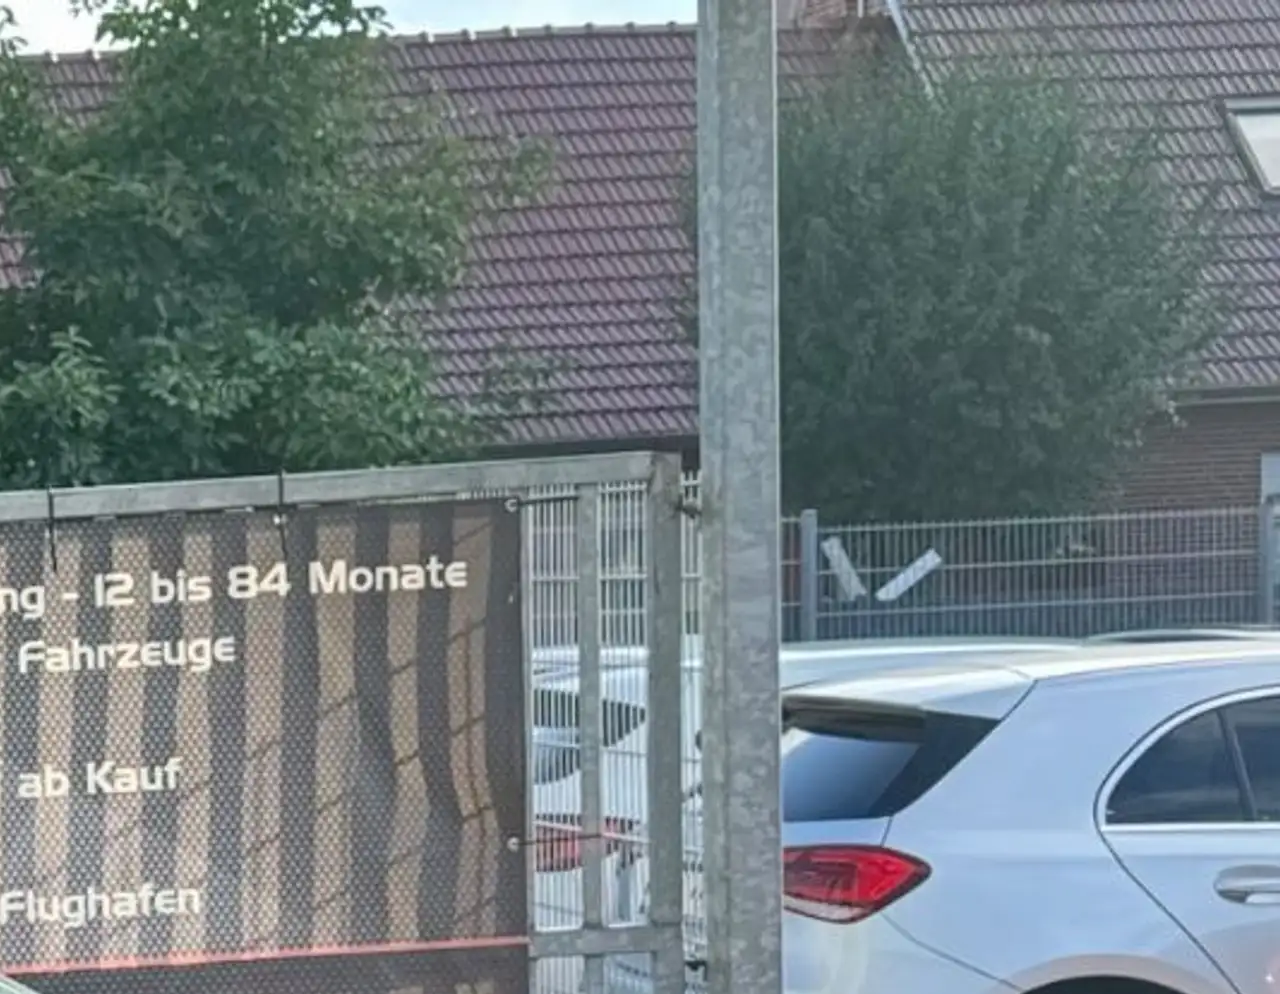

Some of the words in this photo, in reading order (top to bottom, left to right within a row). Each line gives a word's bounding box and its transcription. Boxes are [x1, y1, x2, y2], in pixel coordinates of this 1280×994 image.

[94, 574, 134, 606] 12
[151, 569, 210, 603] bis
[228, 568, 291, 601] 84
[309, 558, 468, 594] Monate
[19, 635, 236, 675] Fahrzeuge
[18, 762, 69, 800] ab
[88, 757, 183, 796] Kauf
[0, 882, 201, 928] Flughafen
